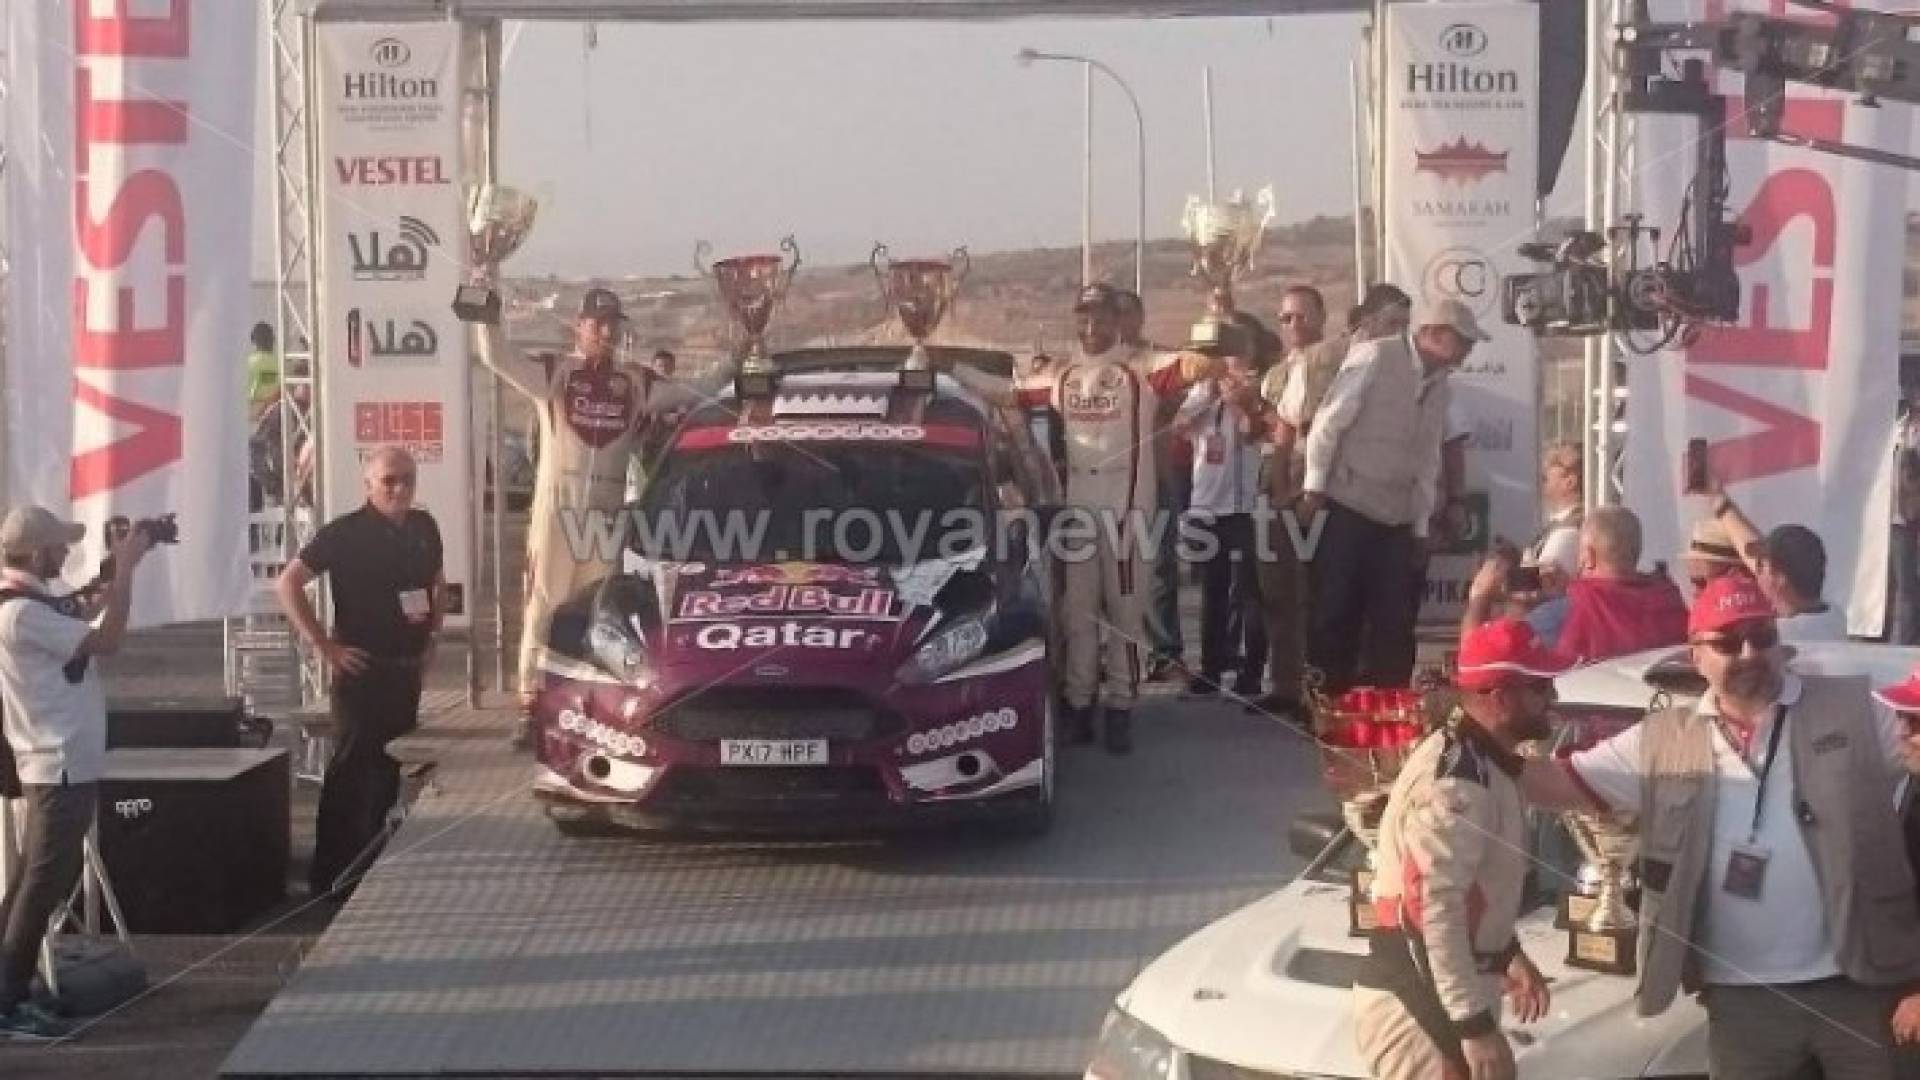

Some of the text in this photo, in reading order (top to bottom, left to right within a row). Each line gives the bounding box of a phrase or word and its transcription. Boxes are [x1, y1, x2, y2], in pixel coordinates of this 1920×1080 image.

[344, 72, 437, 98] Hilton
[1407, 63, 1518, 93] Hilton
[335, 156, 451, 185] VESTEL
[366, 320, 438, 357] هلا
[680, 585, 894, 617] Red Bull
[696, 622, 865, 649] Qatar
[779, 743, 820, 761] HPF
